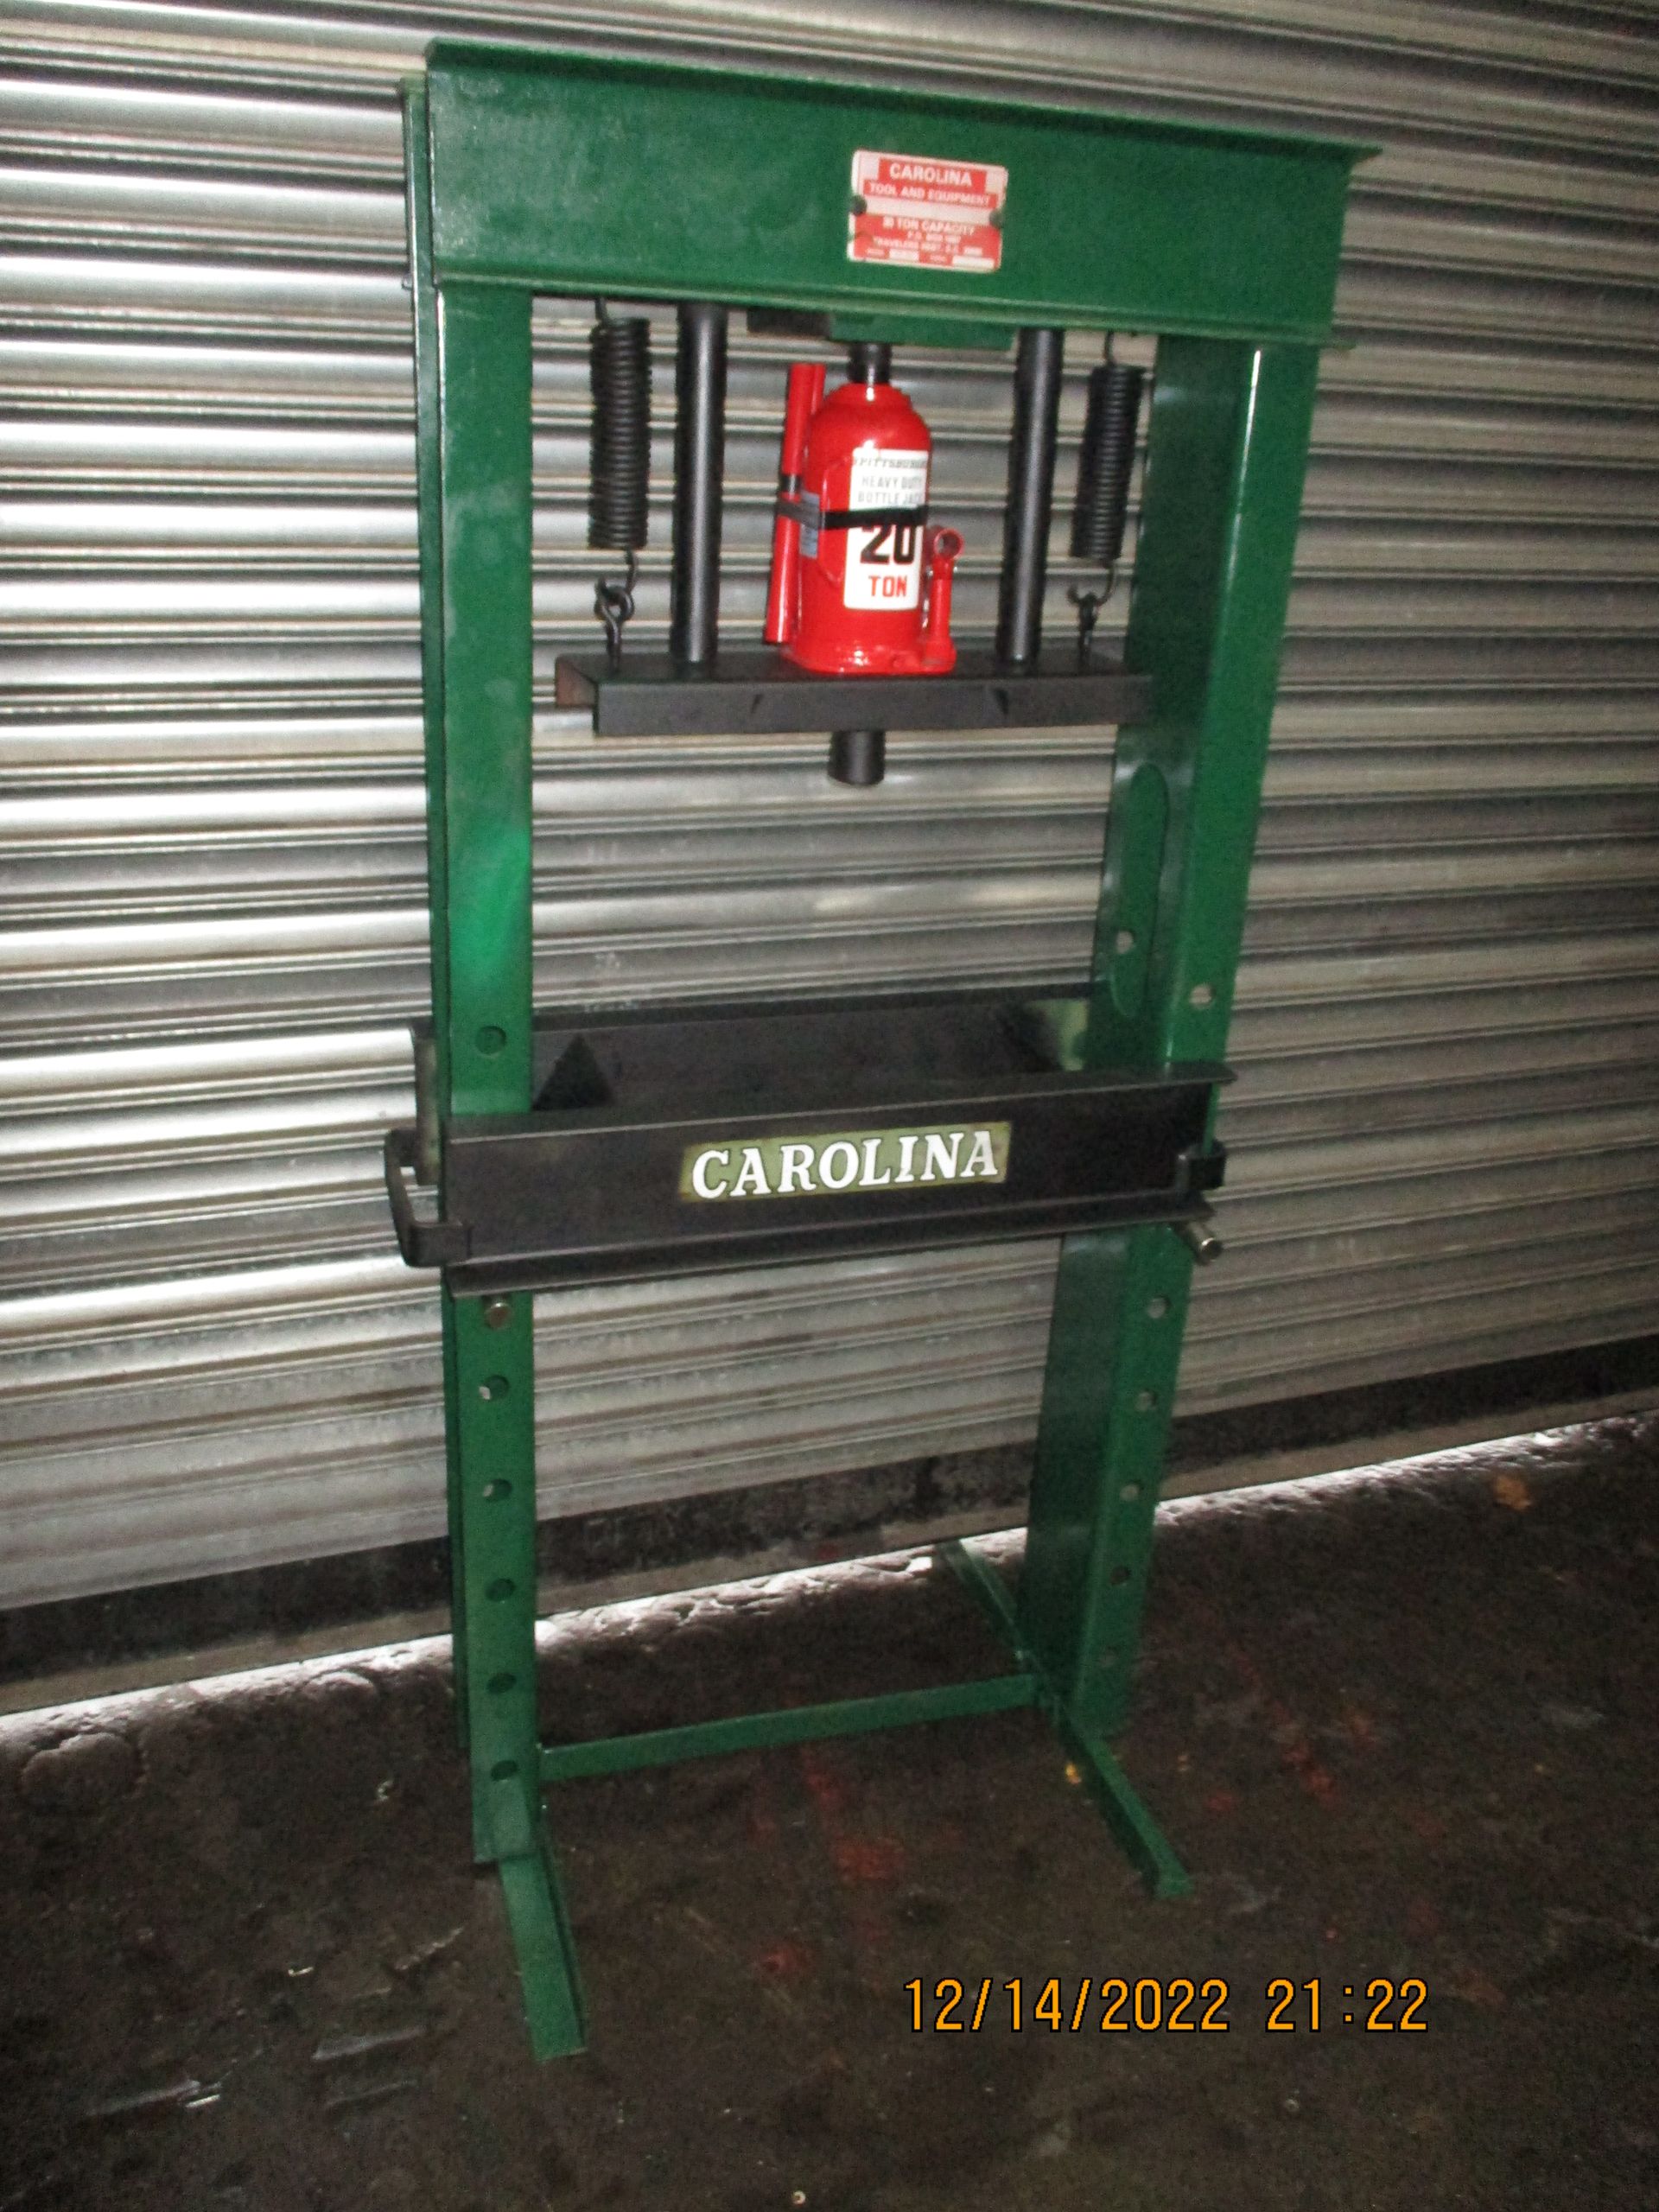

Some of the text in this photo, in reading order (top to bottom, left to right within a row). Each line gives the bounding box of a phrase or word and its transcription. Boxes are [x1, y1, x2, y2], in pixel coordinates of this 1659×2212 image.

[889, 162, 973, 186] CAROLINA
[869, 181, 990, 205] TOOL AND EQUIPMENT
[922, 219, 976, 235] CAPACITY
[861, 475, 899, 488] HEAVY
[857, 490, 900, 505] BOTTLE
[860, 524, 915, 564] 20
[868, 575, 907, 597] TON
[691, 1130, 998, 1199] CAROLINA
